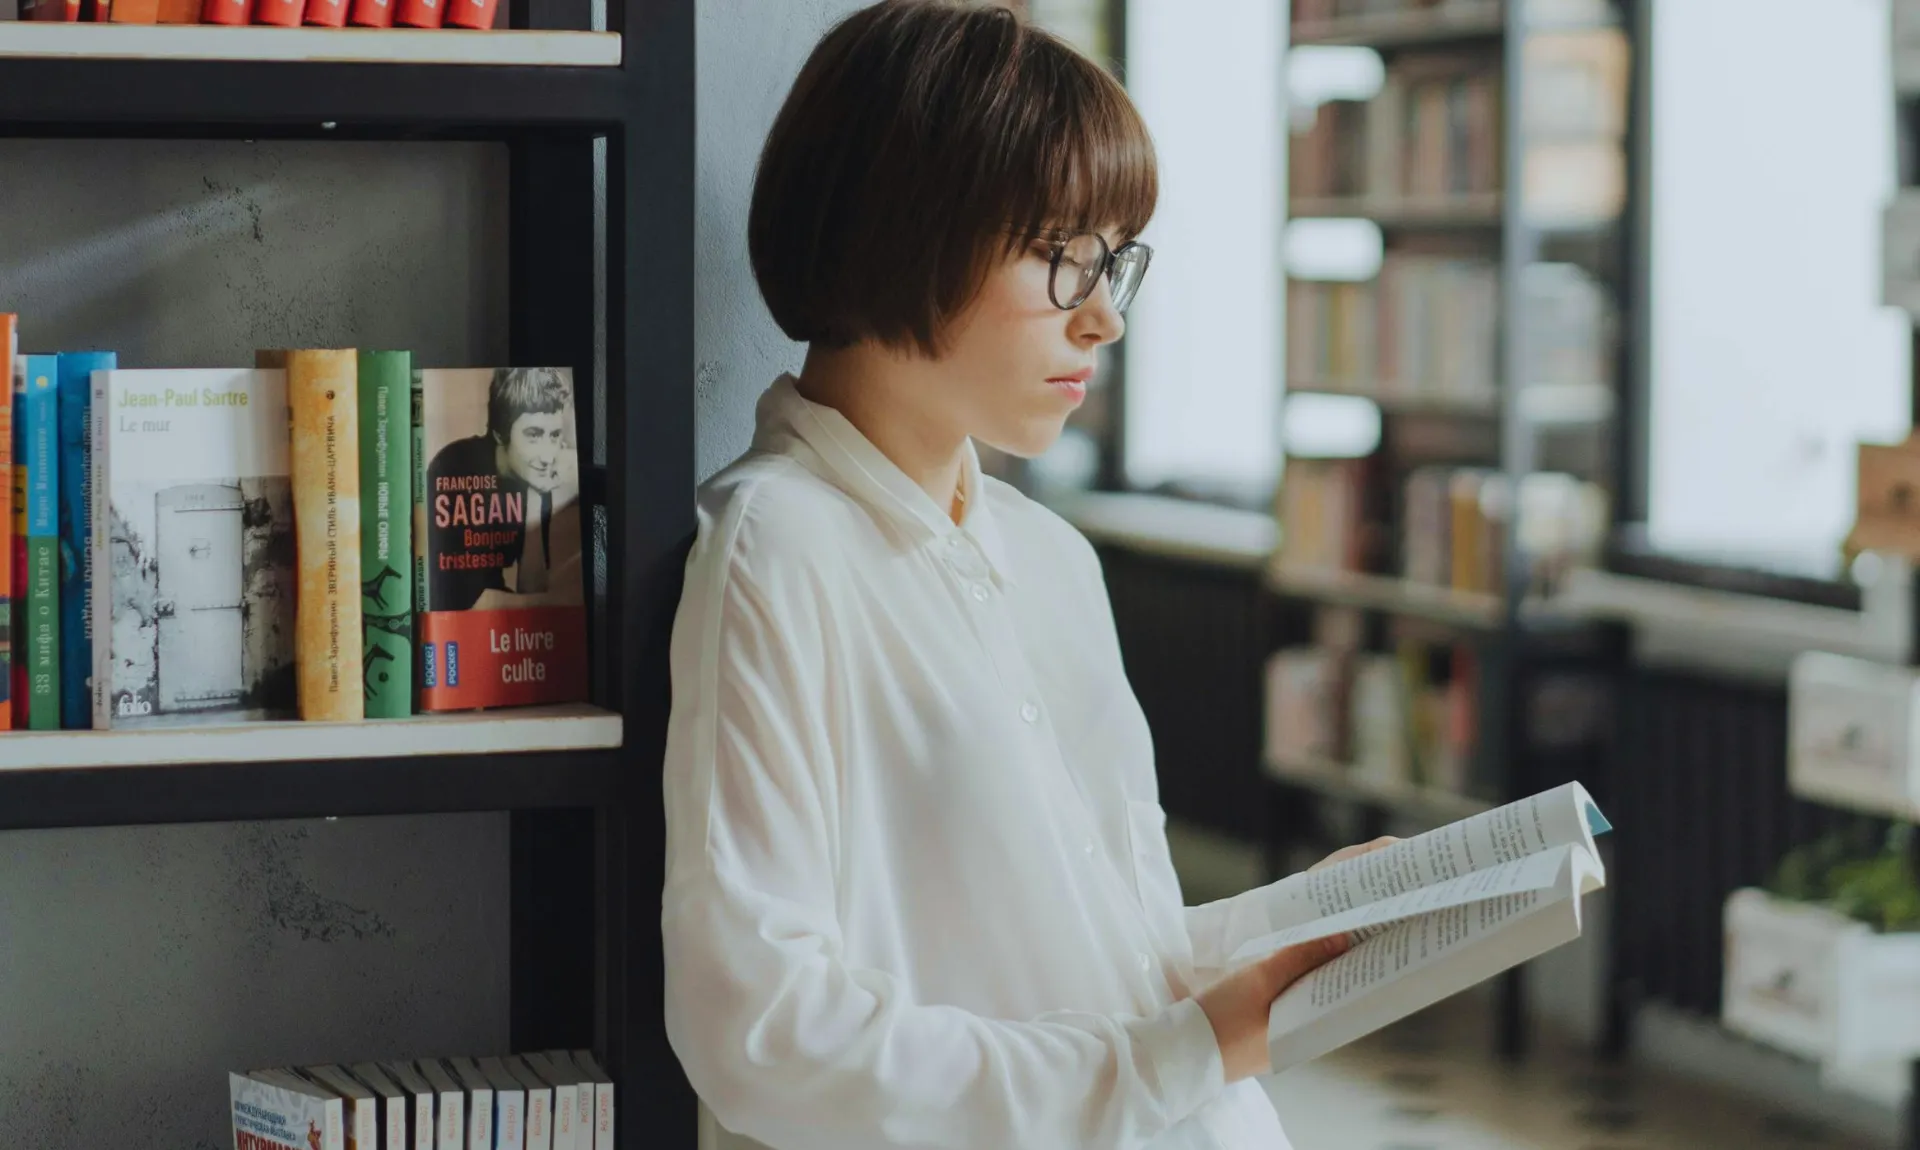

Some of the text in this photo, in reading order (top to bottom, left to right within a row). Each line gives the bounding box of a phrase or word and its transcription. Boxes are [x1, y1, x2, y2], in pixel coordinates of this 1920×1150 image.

[119, 387, 198, 408] Jean-Paul
[202, 387, 249, 407] Sartre
[119, 415, 171, 432] Le mur
[375, 386, 389, 560] Павел Зарифуллин НОВЫЕ СКИФЫ
[435, 475, 498, 494] FRANÇOISE
[435, 492, 523, 528] SAGAN
[464, 528, 518, 550] Bonjour
[326, 415, 340, 693] Павел Зарифуллин ЗВЕРИНЫЙ СТИЛЬ ИВАНА-ЦАРЕВИЧА
[439, 552, 505, 570] tristesse
[35, 547, 50, 598] Китае
[39, 606, 49, 616] о
[35, 623, 53, 666] мифа
[490, 627, 554, 653] Le livre
[502, 657, 546, 684] culte
[35, 673, 51, 696] 33
[119, 694, 152, 716] folio
